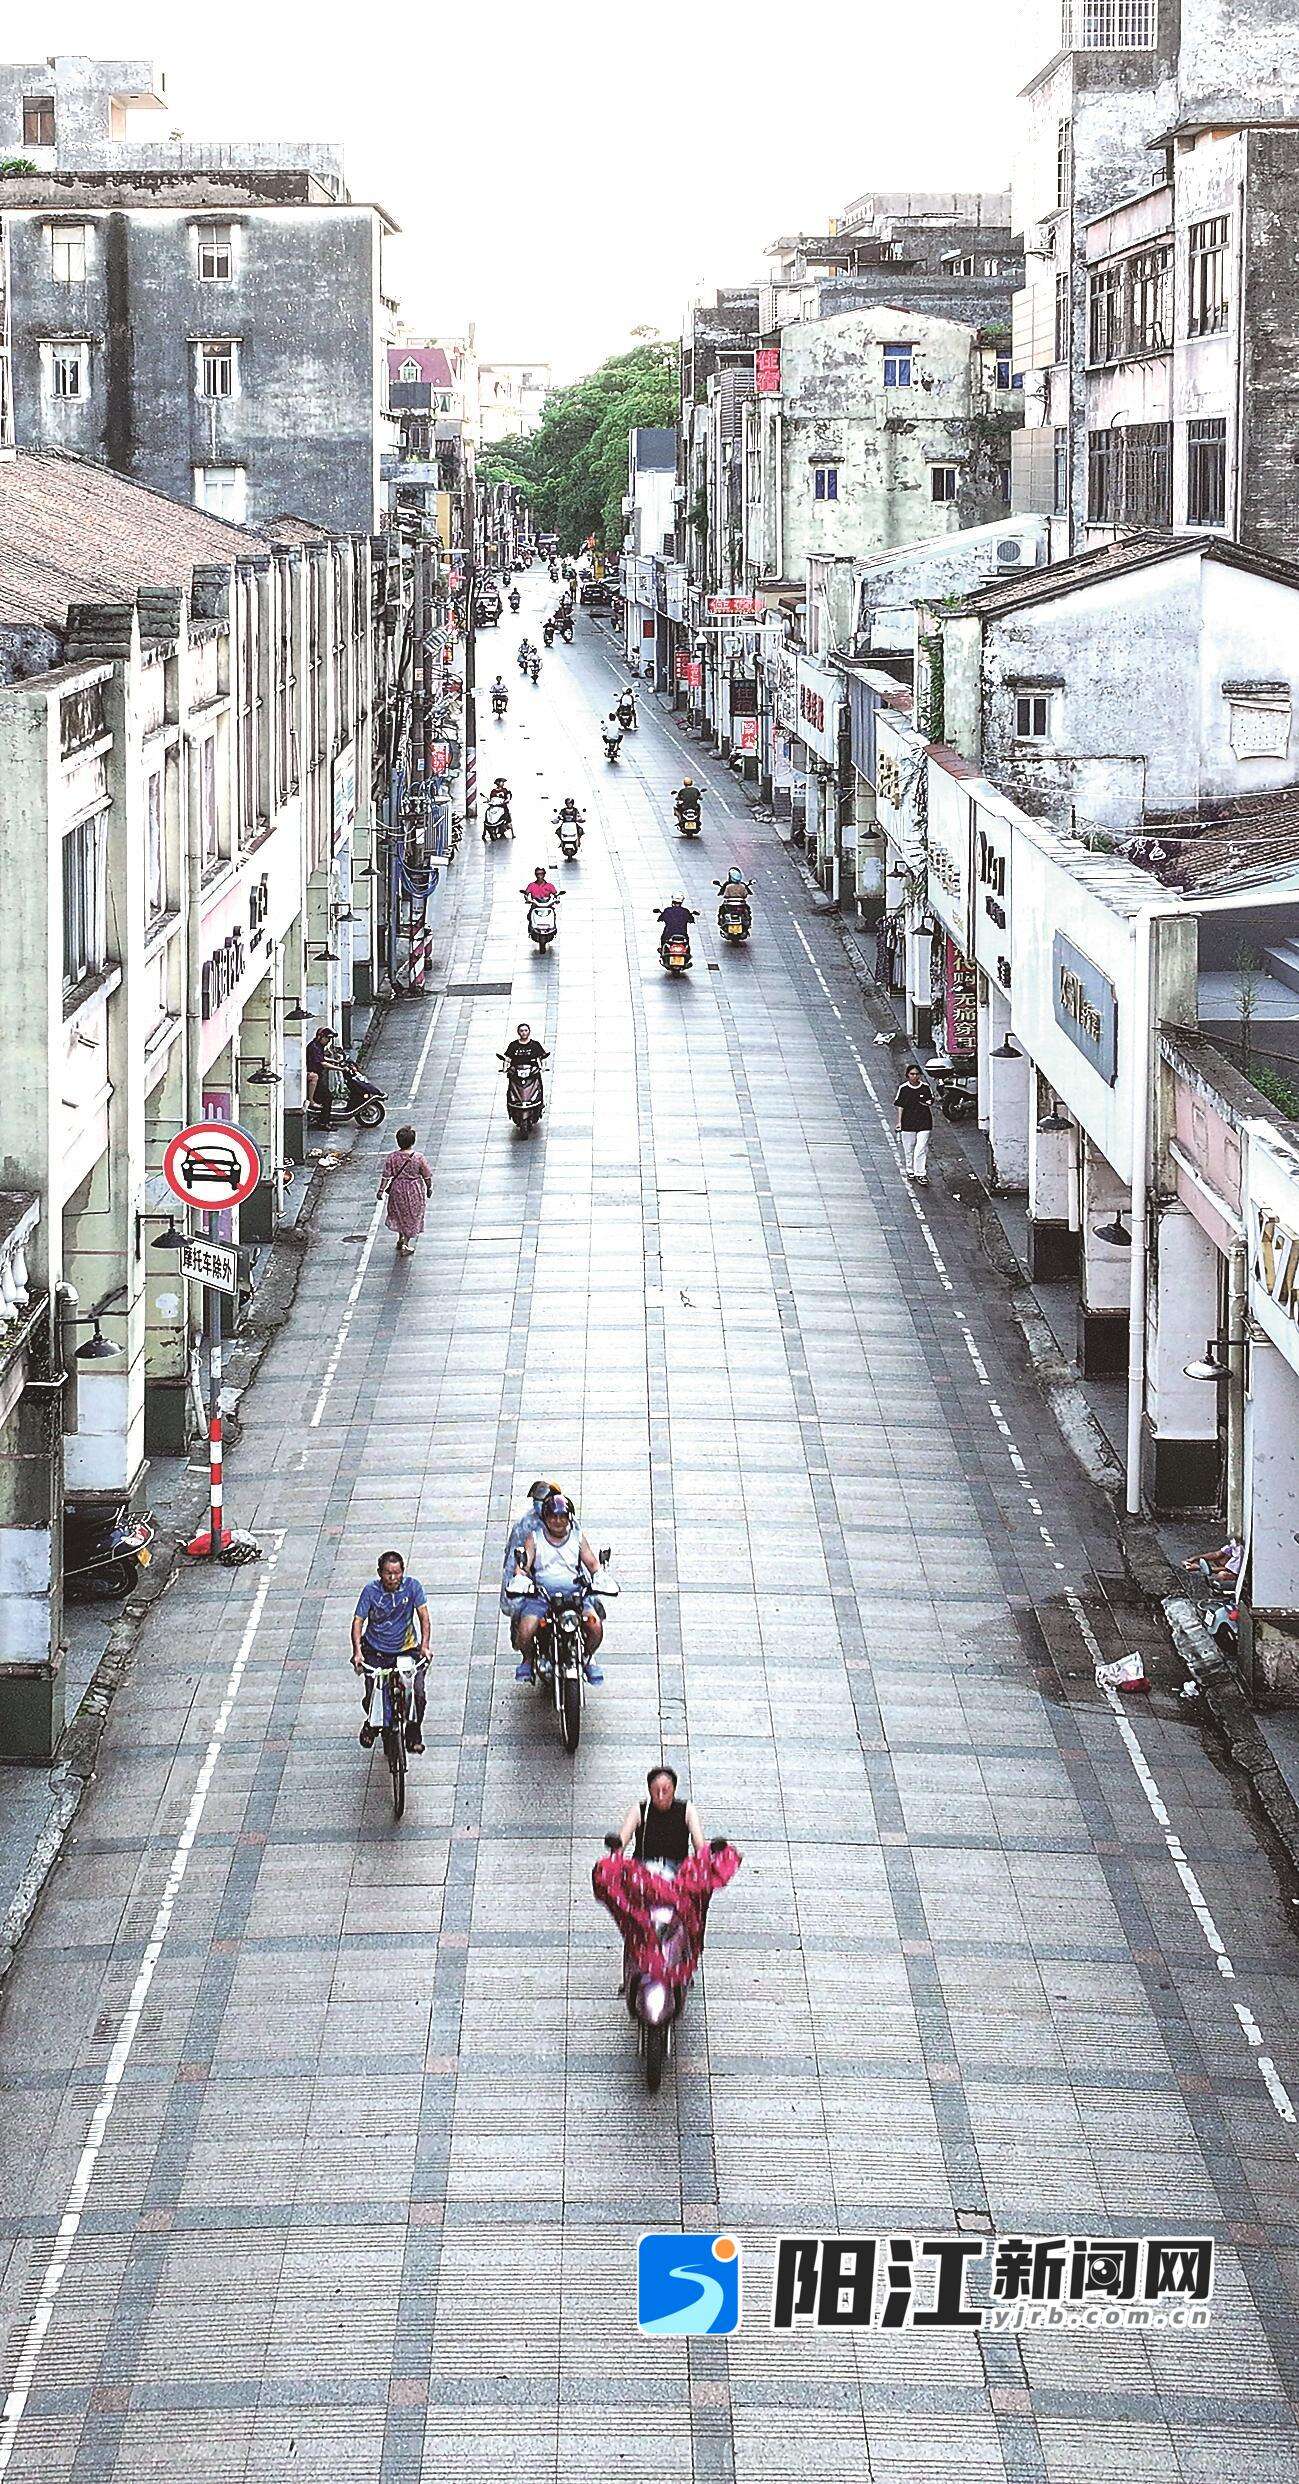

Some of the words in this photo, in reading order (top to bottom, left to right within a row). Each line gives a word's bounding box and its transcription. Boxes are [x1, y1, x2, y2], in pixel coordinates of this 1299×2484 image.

[182, 1245, 232, 1284] 摩托车除外
